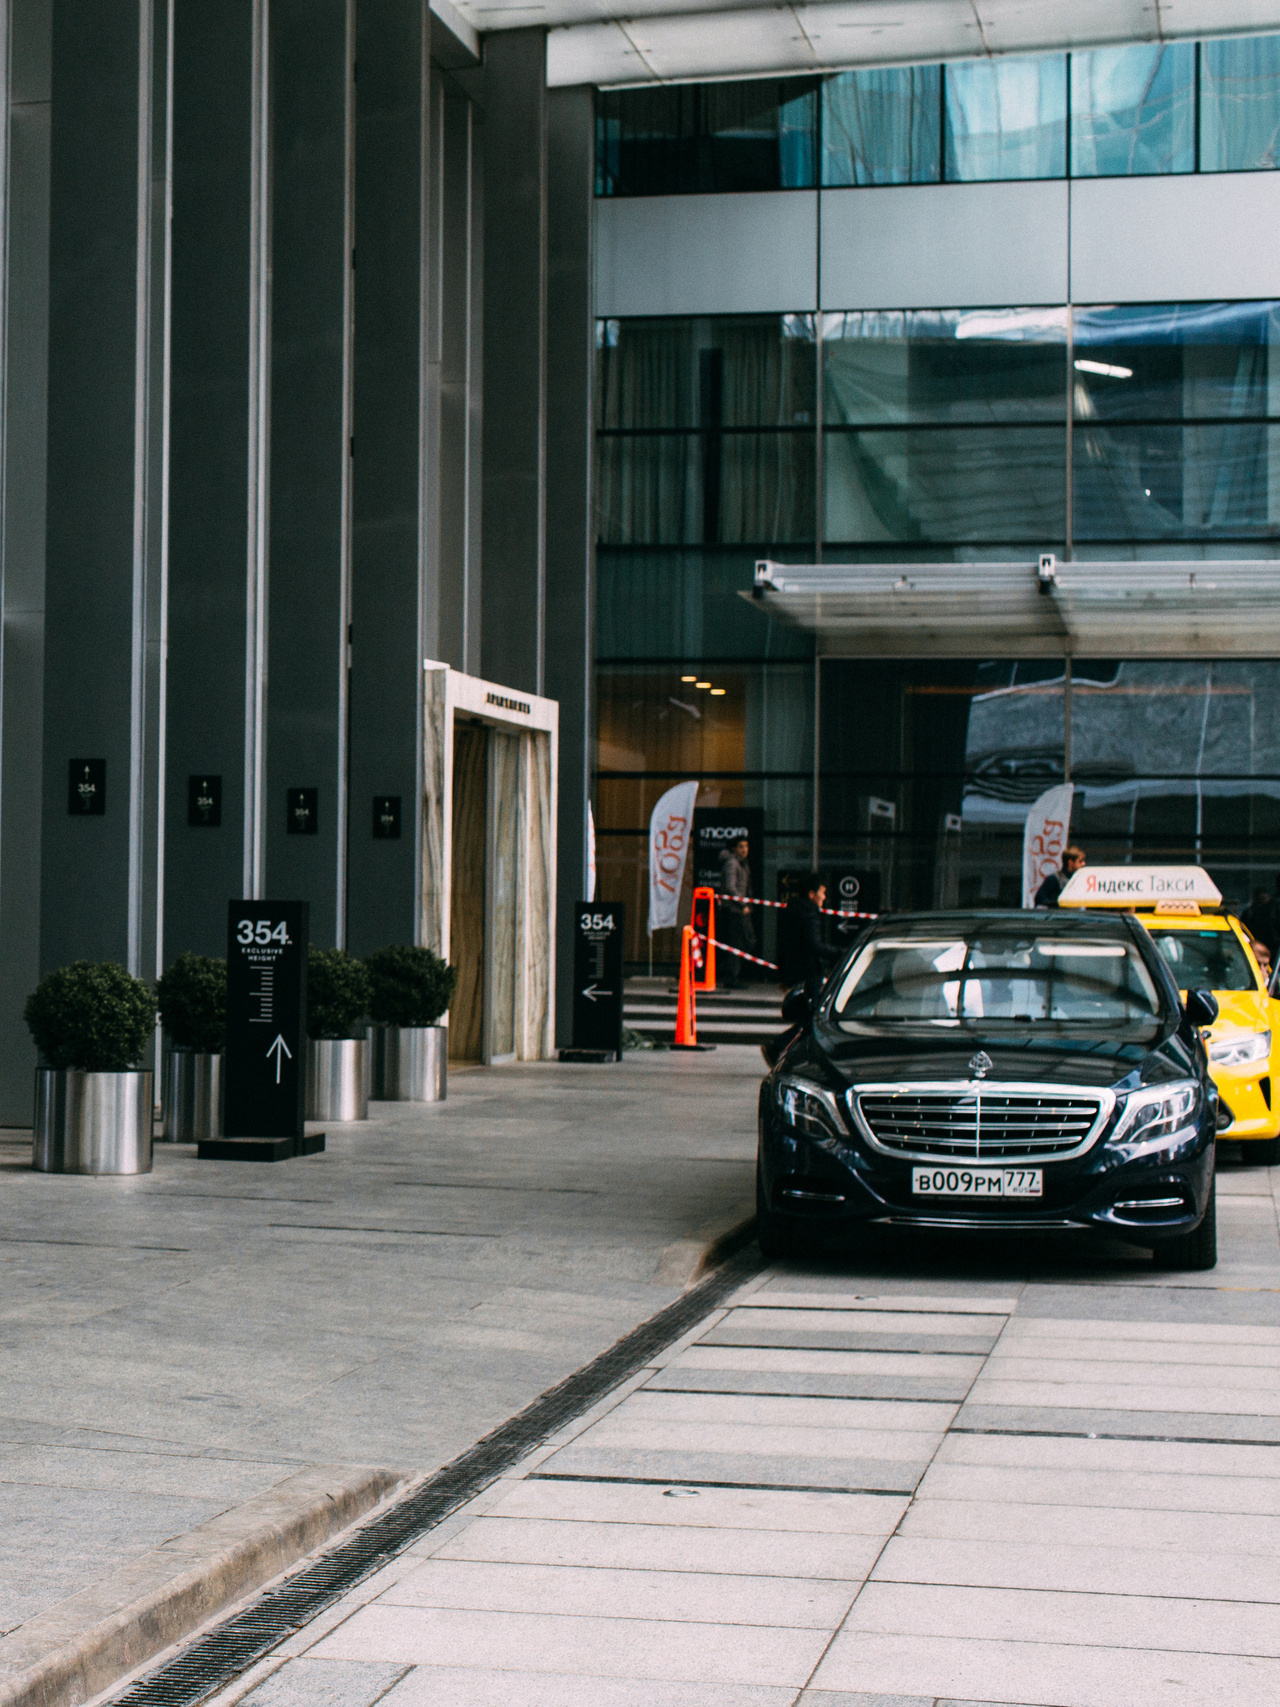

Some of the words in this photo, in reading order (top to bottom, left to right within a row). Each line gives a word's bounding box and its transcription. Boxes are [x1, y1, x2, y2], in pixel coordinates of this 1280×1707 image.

[78, 783, 96, 793] 354
[1086, 874, 1143, 893] Яндекс
[1150, 875, 1195, 892] Такси
[1005, 1171, 1036, 1187] 777
